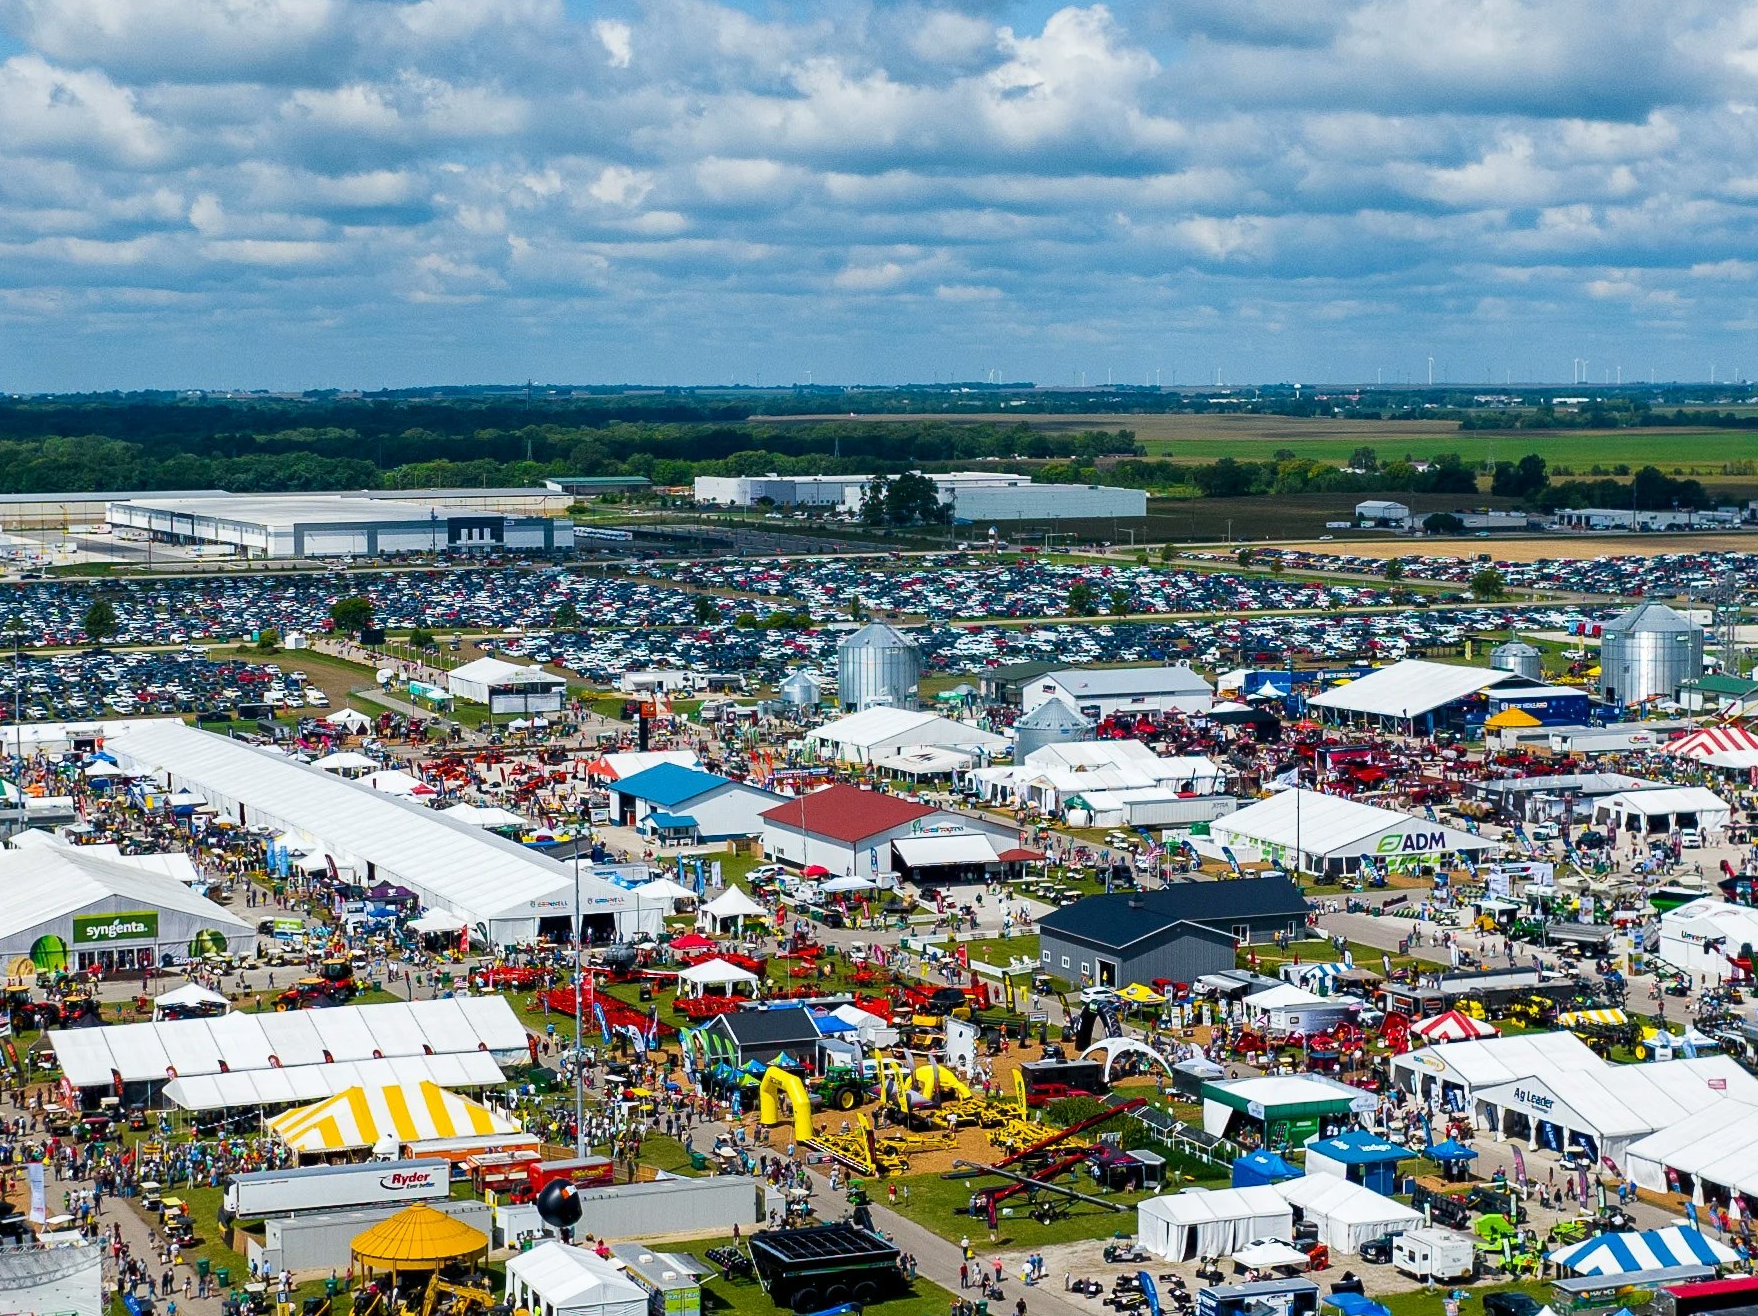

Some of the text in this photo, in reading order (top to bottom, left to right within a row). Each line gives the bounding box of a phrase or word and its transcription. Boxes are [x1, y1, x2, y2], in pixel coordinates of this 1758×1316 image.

[1402, 832, 1446, 851] ADM
[86, 920, 145, 940] syngenta
[1514, 1087, 1554, 1109] Ag Leader
[391, 1172, 431, 1186] Ryder
